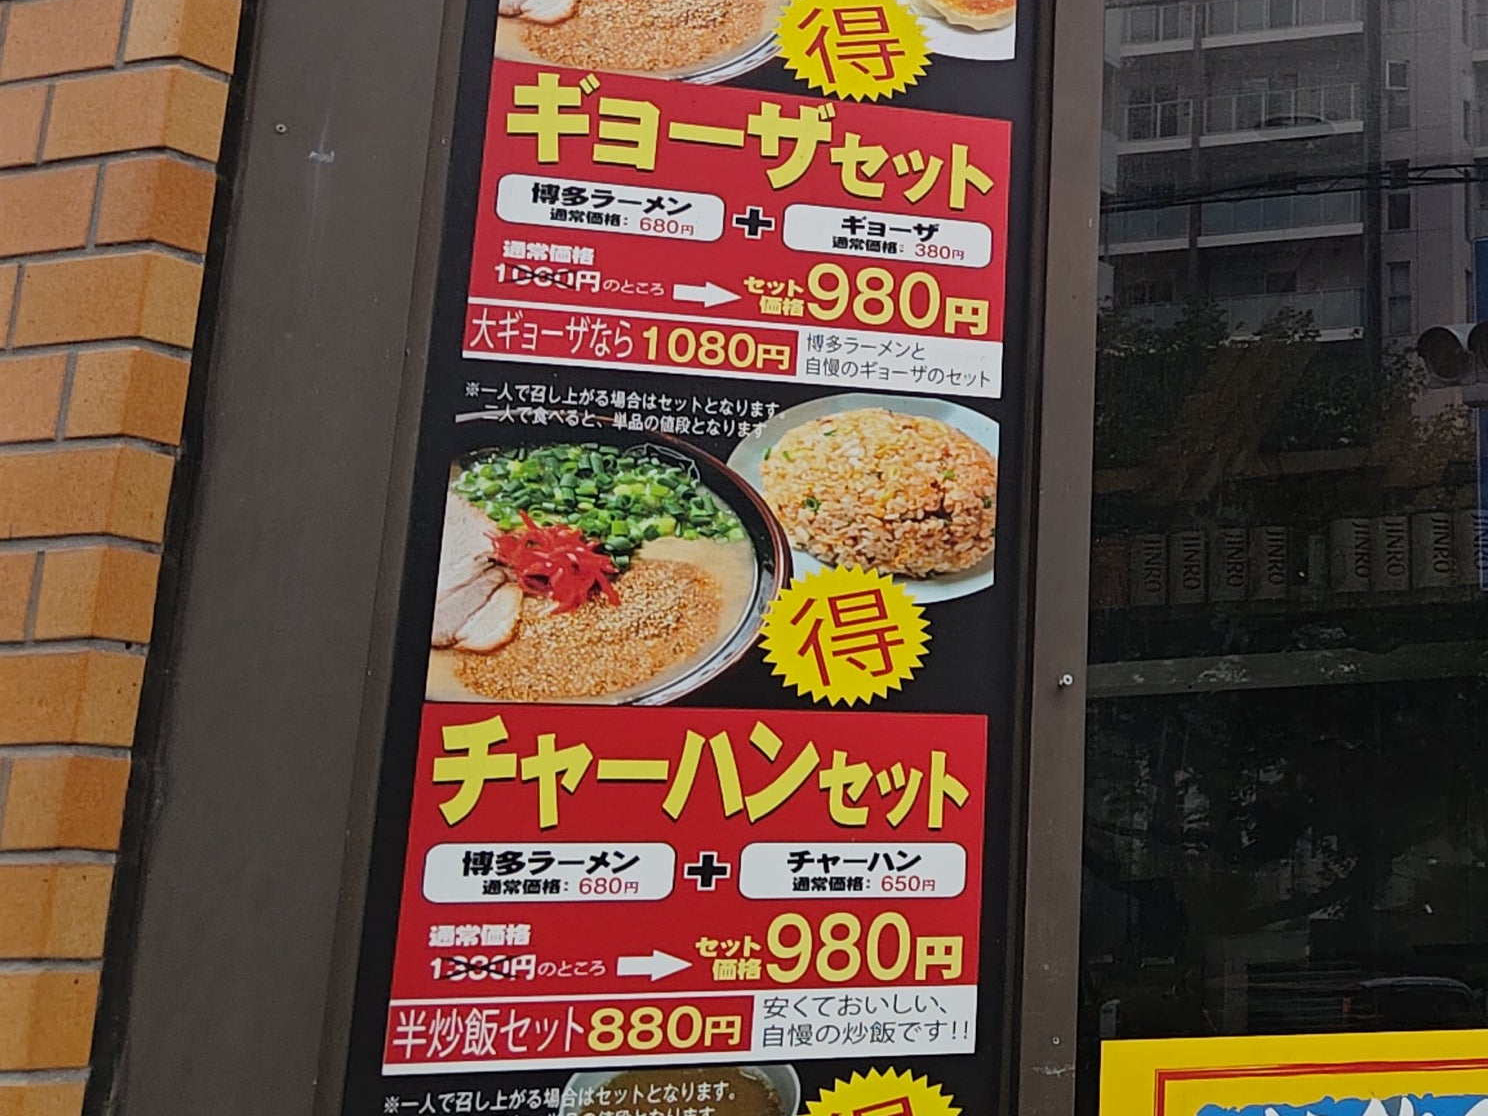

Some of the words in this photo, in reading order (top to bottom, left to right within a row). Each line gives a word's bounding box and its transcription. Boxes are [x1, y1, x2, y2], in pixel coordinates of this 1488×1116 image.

[797, 4, 906, 86] 得
[506, 72, 994, 211] ギョーザセット
[532, 182, 694, 217] 博多ラーメン
[638, 215, 695, 237] 680円
[840, 215, 940, 242] ギョーザ
[502, 239, 595, 268] 通常価格
[914, 242, 966, 263] 380円
[744, 276, 805, 300] セット
[806, 263, 990, 337] 980円
[759, 296, 805, 318] 価格
[470, 314, 635, 362] 大ギョーザなら
[642, 326, 792, 371] 1080円
[805, 332, 927, 362] 博多ラーメンと
[805, 355, 993, 390] 自慢のギョーザのセット
[1430, 513, 1451, 574] JINRO
[789, 588, 905, 688] 得
[431, 714, 970, 830] チャーハンセット
[461, 850, 642, 877] 博多ラーメン
[786, 850, 923, 874] チャーハン
[578, 876, 640, 896] 680円
[880, 873, 937, 894] 650円
[428, 923, 532, 949] 通常価格
[695, 935, 763, 958] セット
[765, 911, 964, 983] 980円
[711, 957, 763, 982] 価格
[763, 994, 948, 1020] 安くておいしい、
[392, 1006, 584, 1058] 半炒飯セット
[587, 1006, 743, 1052] 880円
[762, 1018, 972, 1049] 自慢の炒飯です!!
